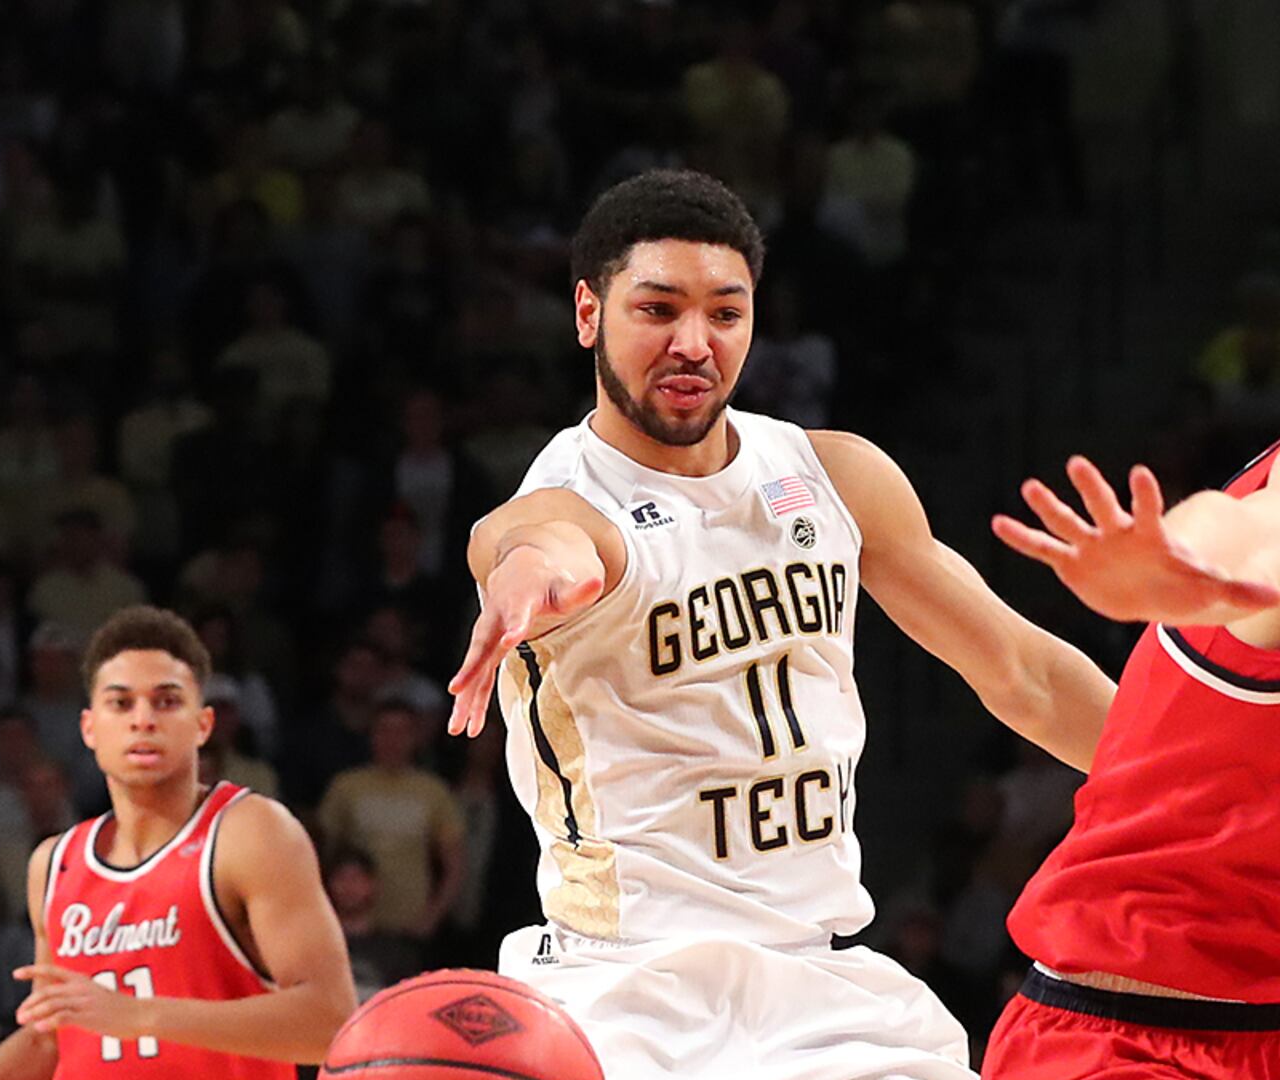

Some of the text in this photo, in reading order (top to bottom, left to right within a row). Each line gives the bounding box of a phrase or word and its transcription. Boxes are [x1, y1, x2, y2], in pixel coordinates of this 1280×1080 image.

[648, 561, 846, 677] GEORGIA
[744, 653, 807, 760] 11
[57, 902, 181, 958] Belmont
